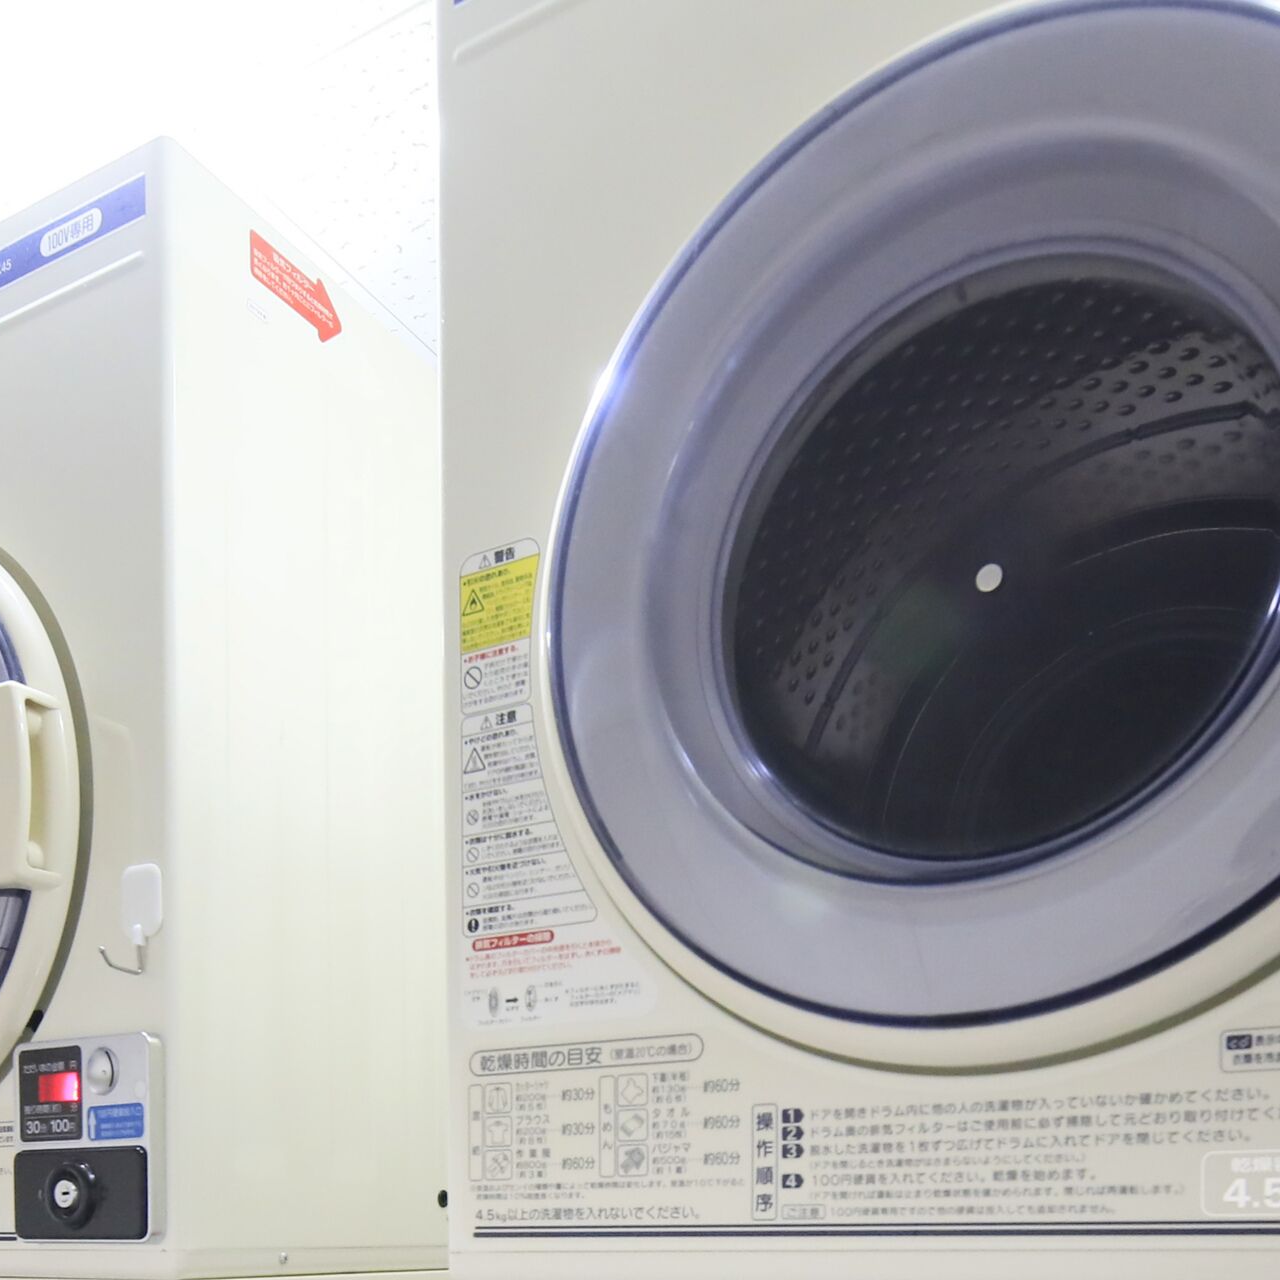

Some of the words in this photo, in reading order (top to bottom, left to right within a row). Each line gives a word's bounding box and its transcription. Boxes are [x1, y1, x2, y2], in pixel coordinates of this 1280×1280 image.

[496, 710, 517, 726] 注意
[479, 1047, 603, 1071] 乾燥時間の目安
[755, 1111, 774, 1213] 操作順序
